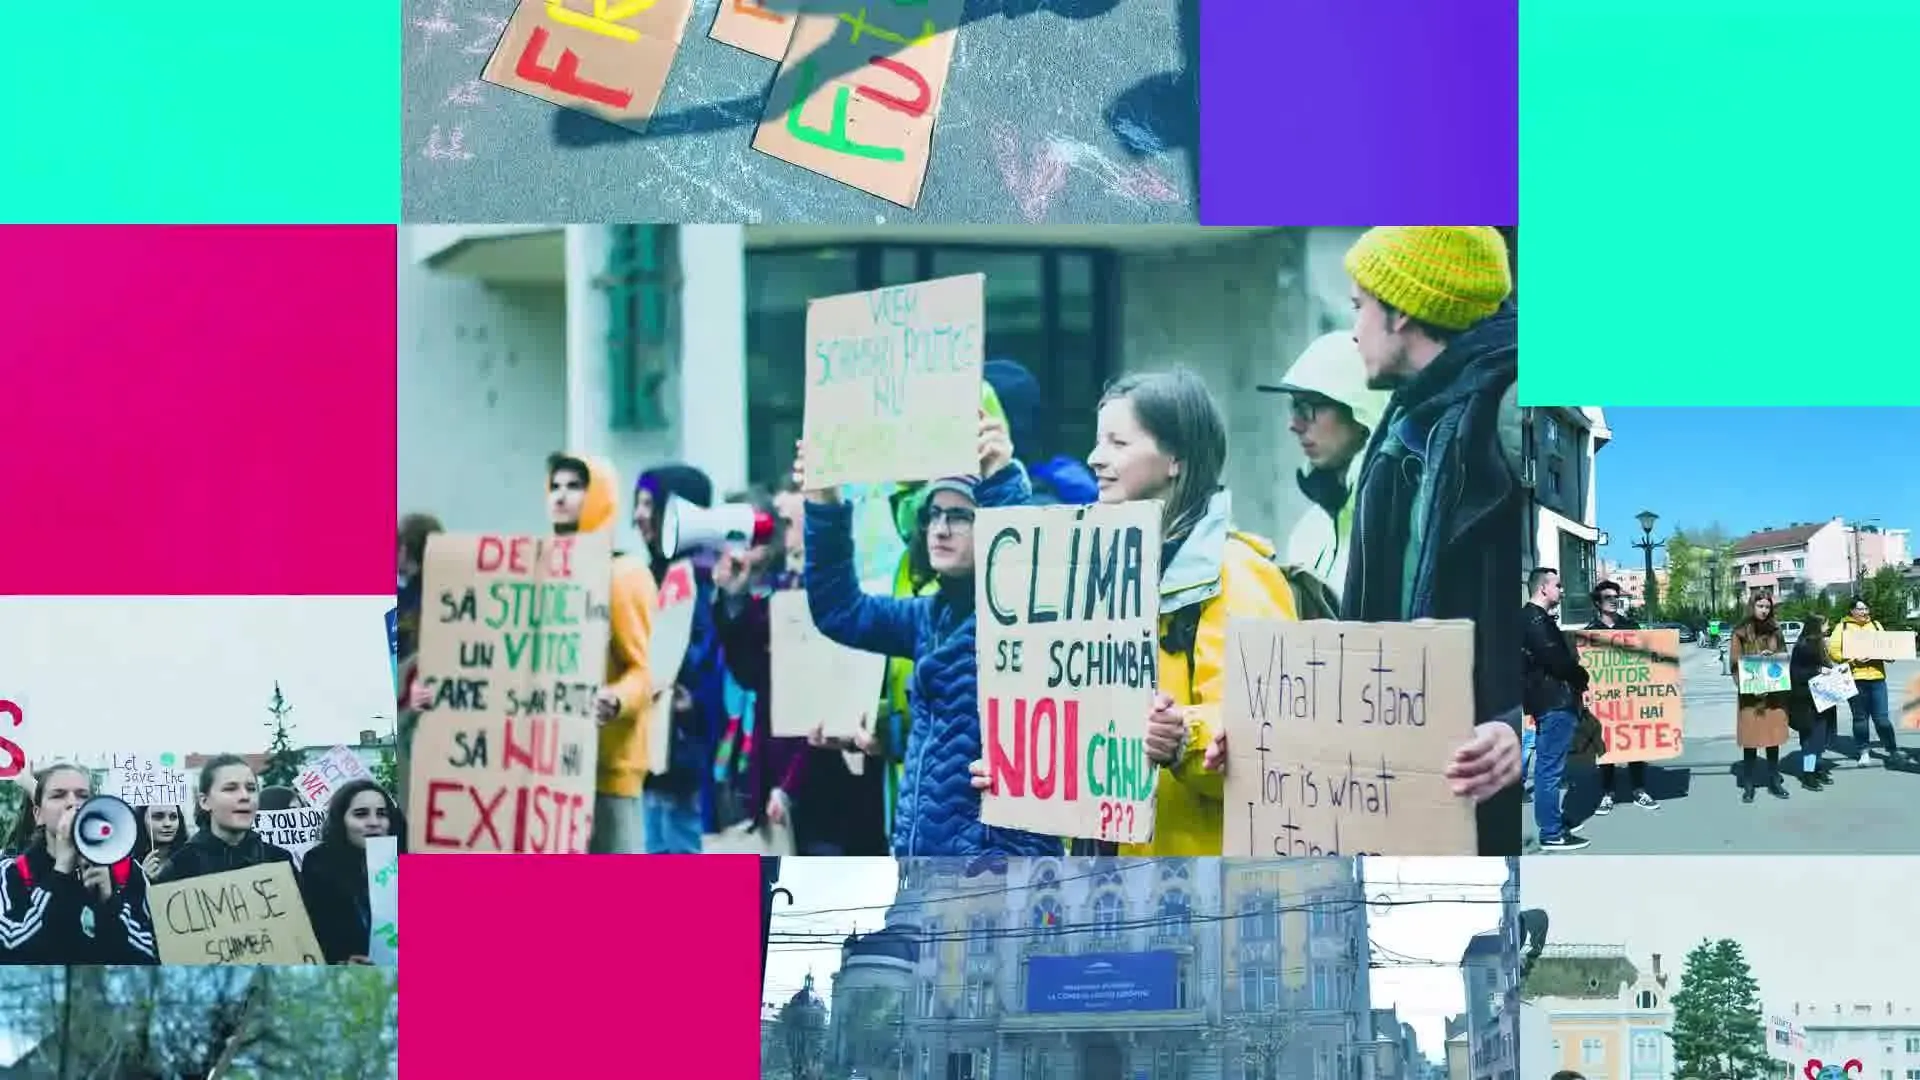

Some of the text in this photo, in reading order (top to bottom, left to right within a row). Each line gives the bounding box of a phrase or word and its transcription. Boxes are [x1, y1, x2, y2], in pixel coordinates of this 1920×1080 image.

[477, 536, 530, 574] DE
[460, 641, 494, 669] UN
[995, 639, 1023, 673] SE
[1238, 632, 1326, 722] What
[1361, 637, 1427, 727] stand
[1590, 666, 1651, 684] VIITOR
[1626, 684, 1677, 699] PUTEA
[503, 717, 559, 777] NU
[987, 697, 1080, 802] NOI
[1604, 722, 1682, 752] ISTE?
[1255, 721, 1396, 818] for is what
[267, 810, 297, 829] YOU
[276, 828, 307, 845] LIKE
[166, 884, 249, 935] CLIMA
